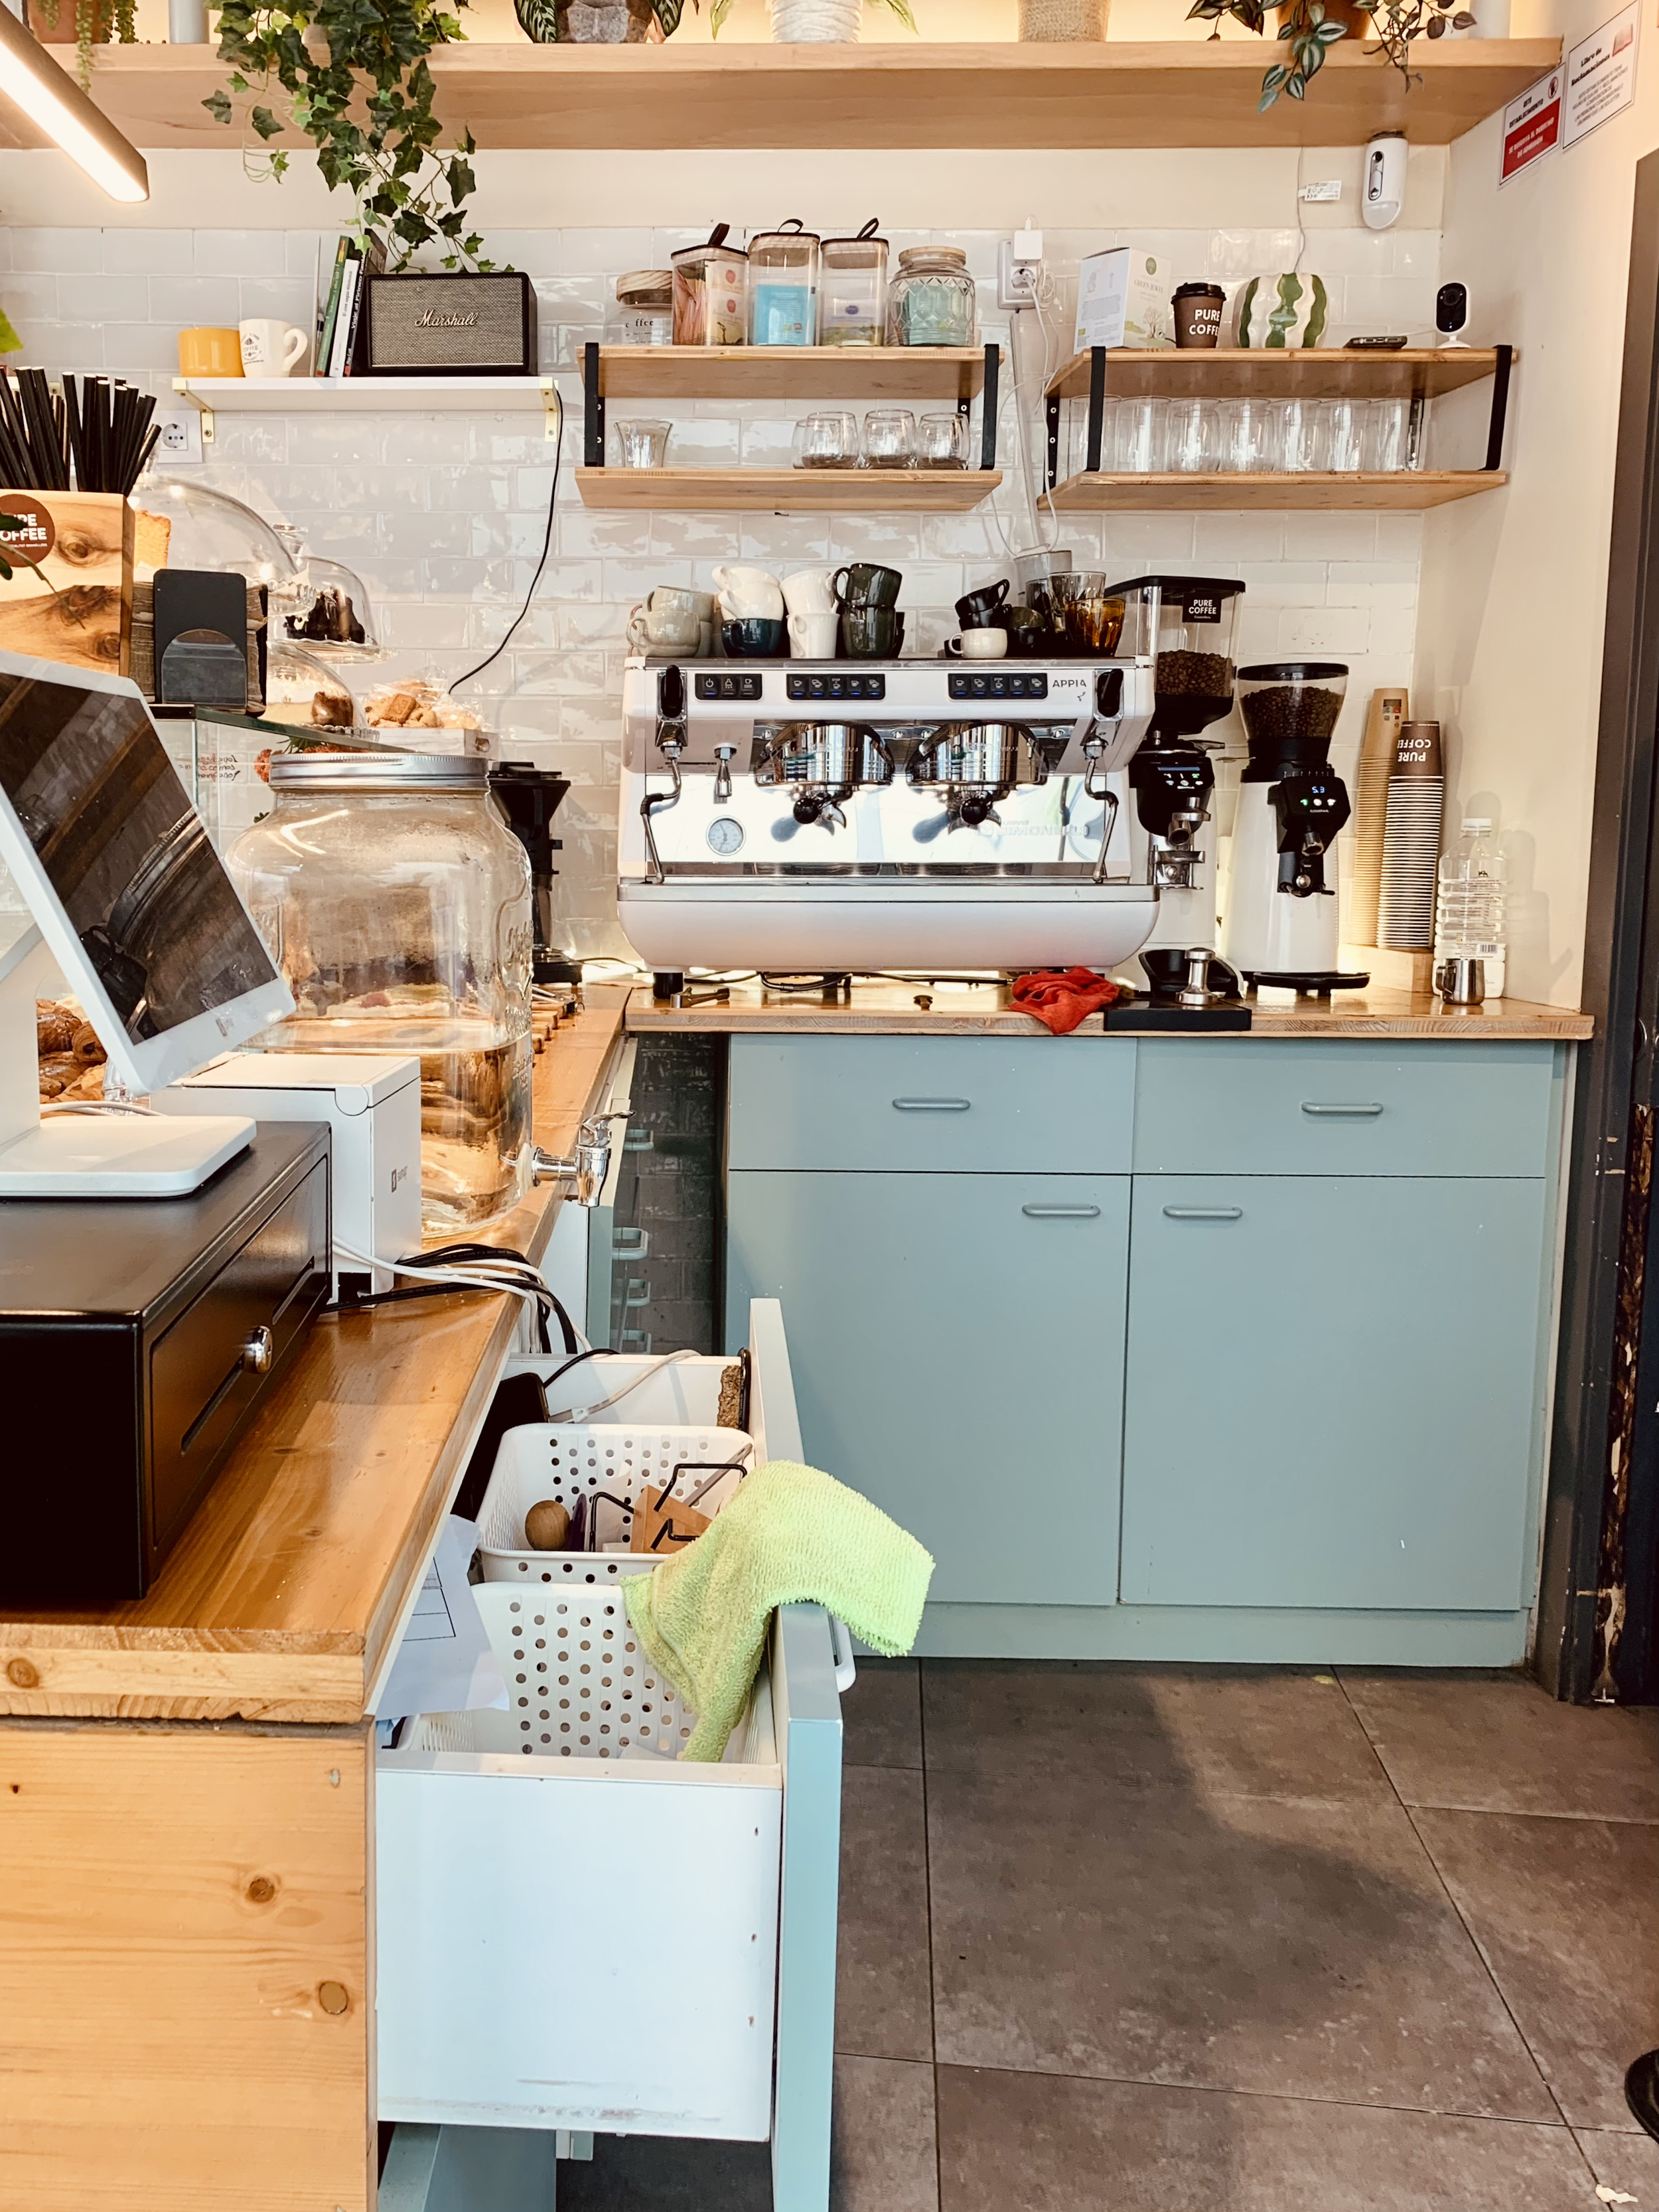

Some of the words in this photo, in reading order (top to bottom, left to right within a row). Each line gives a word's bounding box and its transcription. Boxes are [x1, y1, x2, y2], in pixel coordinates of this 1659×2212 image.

[415, 309, 478, 326] Marshall
[1194, 309, 1220, 321] PURE
[625, 318, 653, 328] cffee
[0, 527, 47, 541] OFFEE
[1398, 752, 1426, 762] PURE
